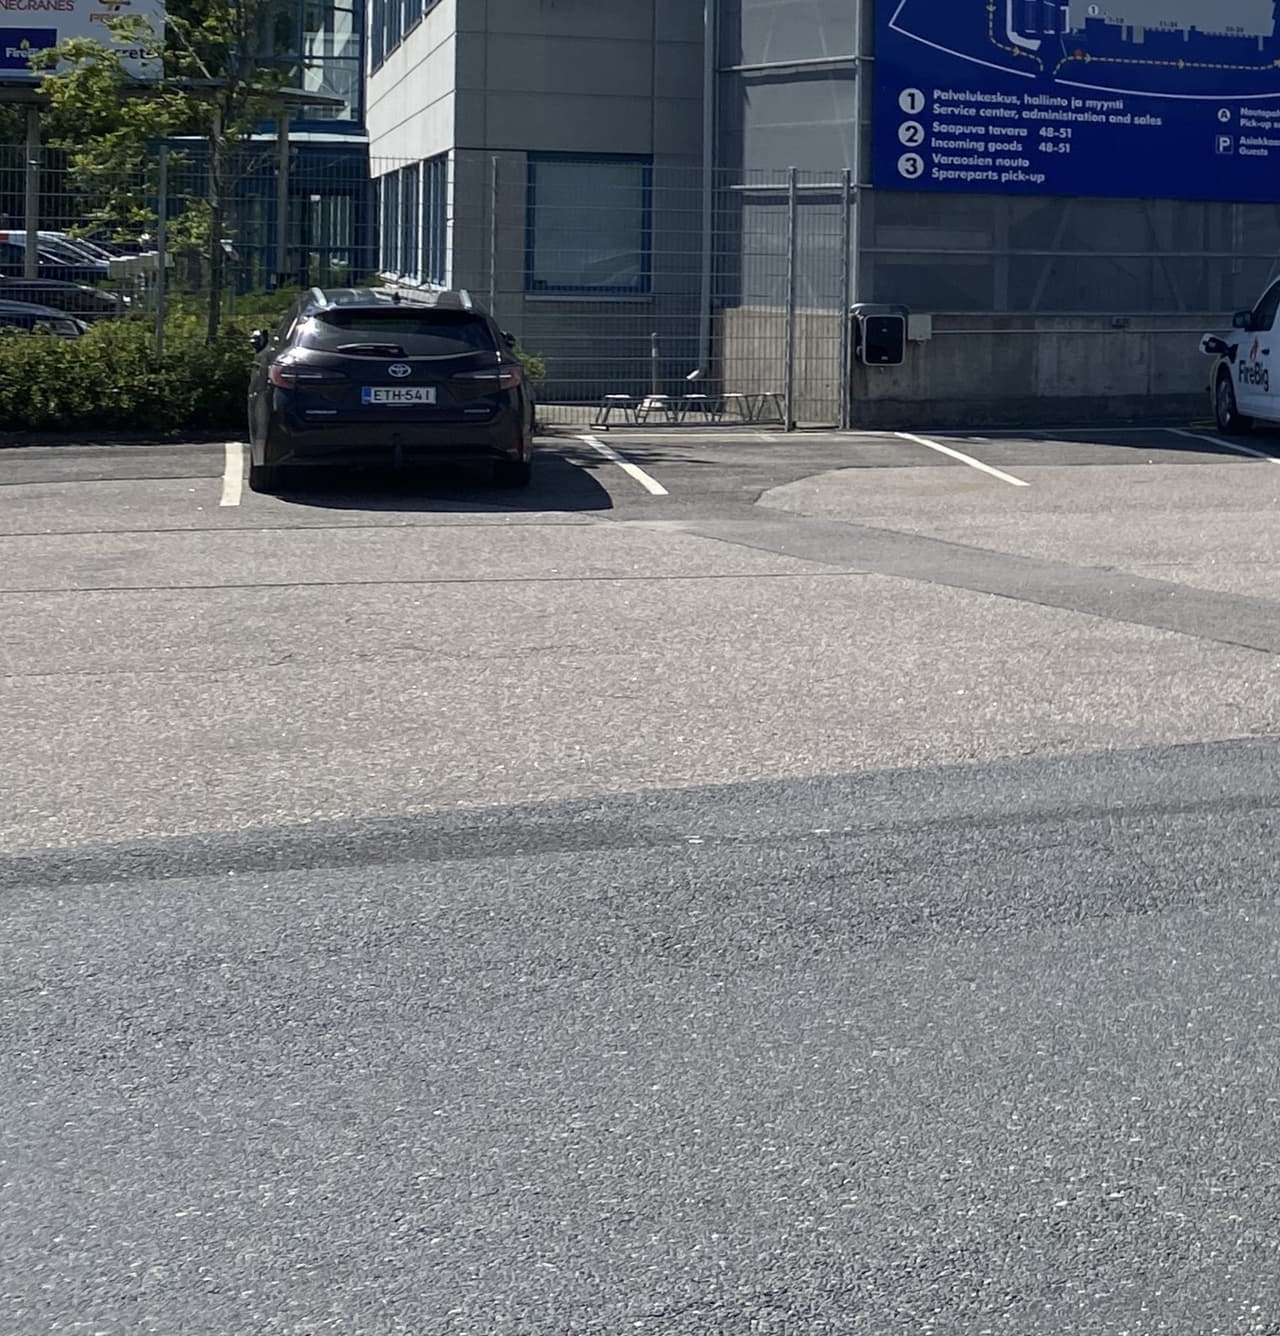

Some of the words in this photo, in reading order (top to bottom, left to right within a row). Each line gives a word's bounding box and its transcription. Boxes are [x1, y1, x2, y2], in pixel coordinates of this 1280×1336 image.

[933, 90, 1021, 105] Palvelukeskus,
[1024, 94, 1068, 107] hallinto
[1071, 97, 1082, 110] ja
[1085, 99, 1123, 111] myynti
[933, 104, 976, 116] Service
[980, 107, 1019, 120] center,
[1022, 109, 1106, 123] administration
[1109, 111, 1131, 124] and
[1134, 114, 1162, 125] sales
[932, 121, 985, 136] Saapuva
[988, 125, 1028, 136] tavara
[1039, 126, 1073, 139] 48-51
[931, 137, 984, 152] Incoming
[988, 140, 1023, 154] goods
[1038, 142, 1071, 154] 48-51
[932, 153, 993, 166] Varaosien
[996, 156, 1029, 168] nouto
[931, 167, 998, 182] Spareparts
[1001, 171, 1045, 183] pick-up
[374, 389, 429, 401] ETH-541
